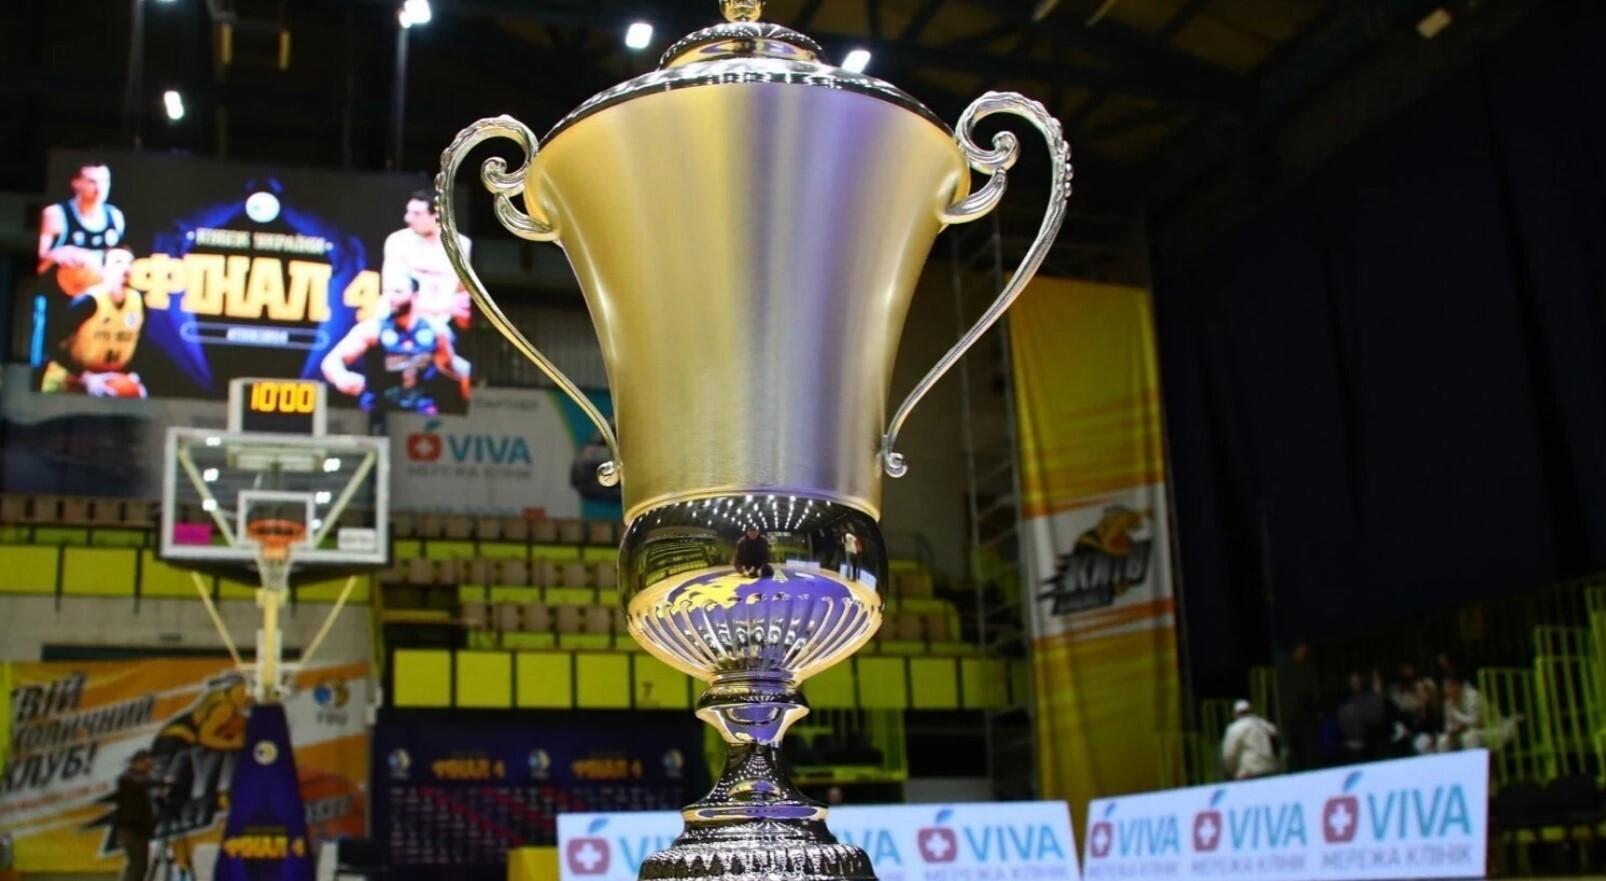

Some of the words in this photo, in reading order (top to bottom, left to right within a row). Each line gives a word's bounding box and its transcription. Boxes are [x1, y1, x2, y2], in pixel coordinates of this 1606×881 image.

[129, 252, 333, 322] ФІНАЛ
[343, 270, 380, 322] 4
[448, 433, 533, 464] VIVA
[1229, 802, 1308, 850] VIVA
[1367, 784, 1473, 842] VIVA
[963, 825, 1065, 863] VIVA
[1118, 815, 1180, 858] VIVA
